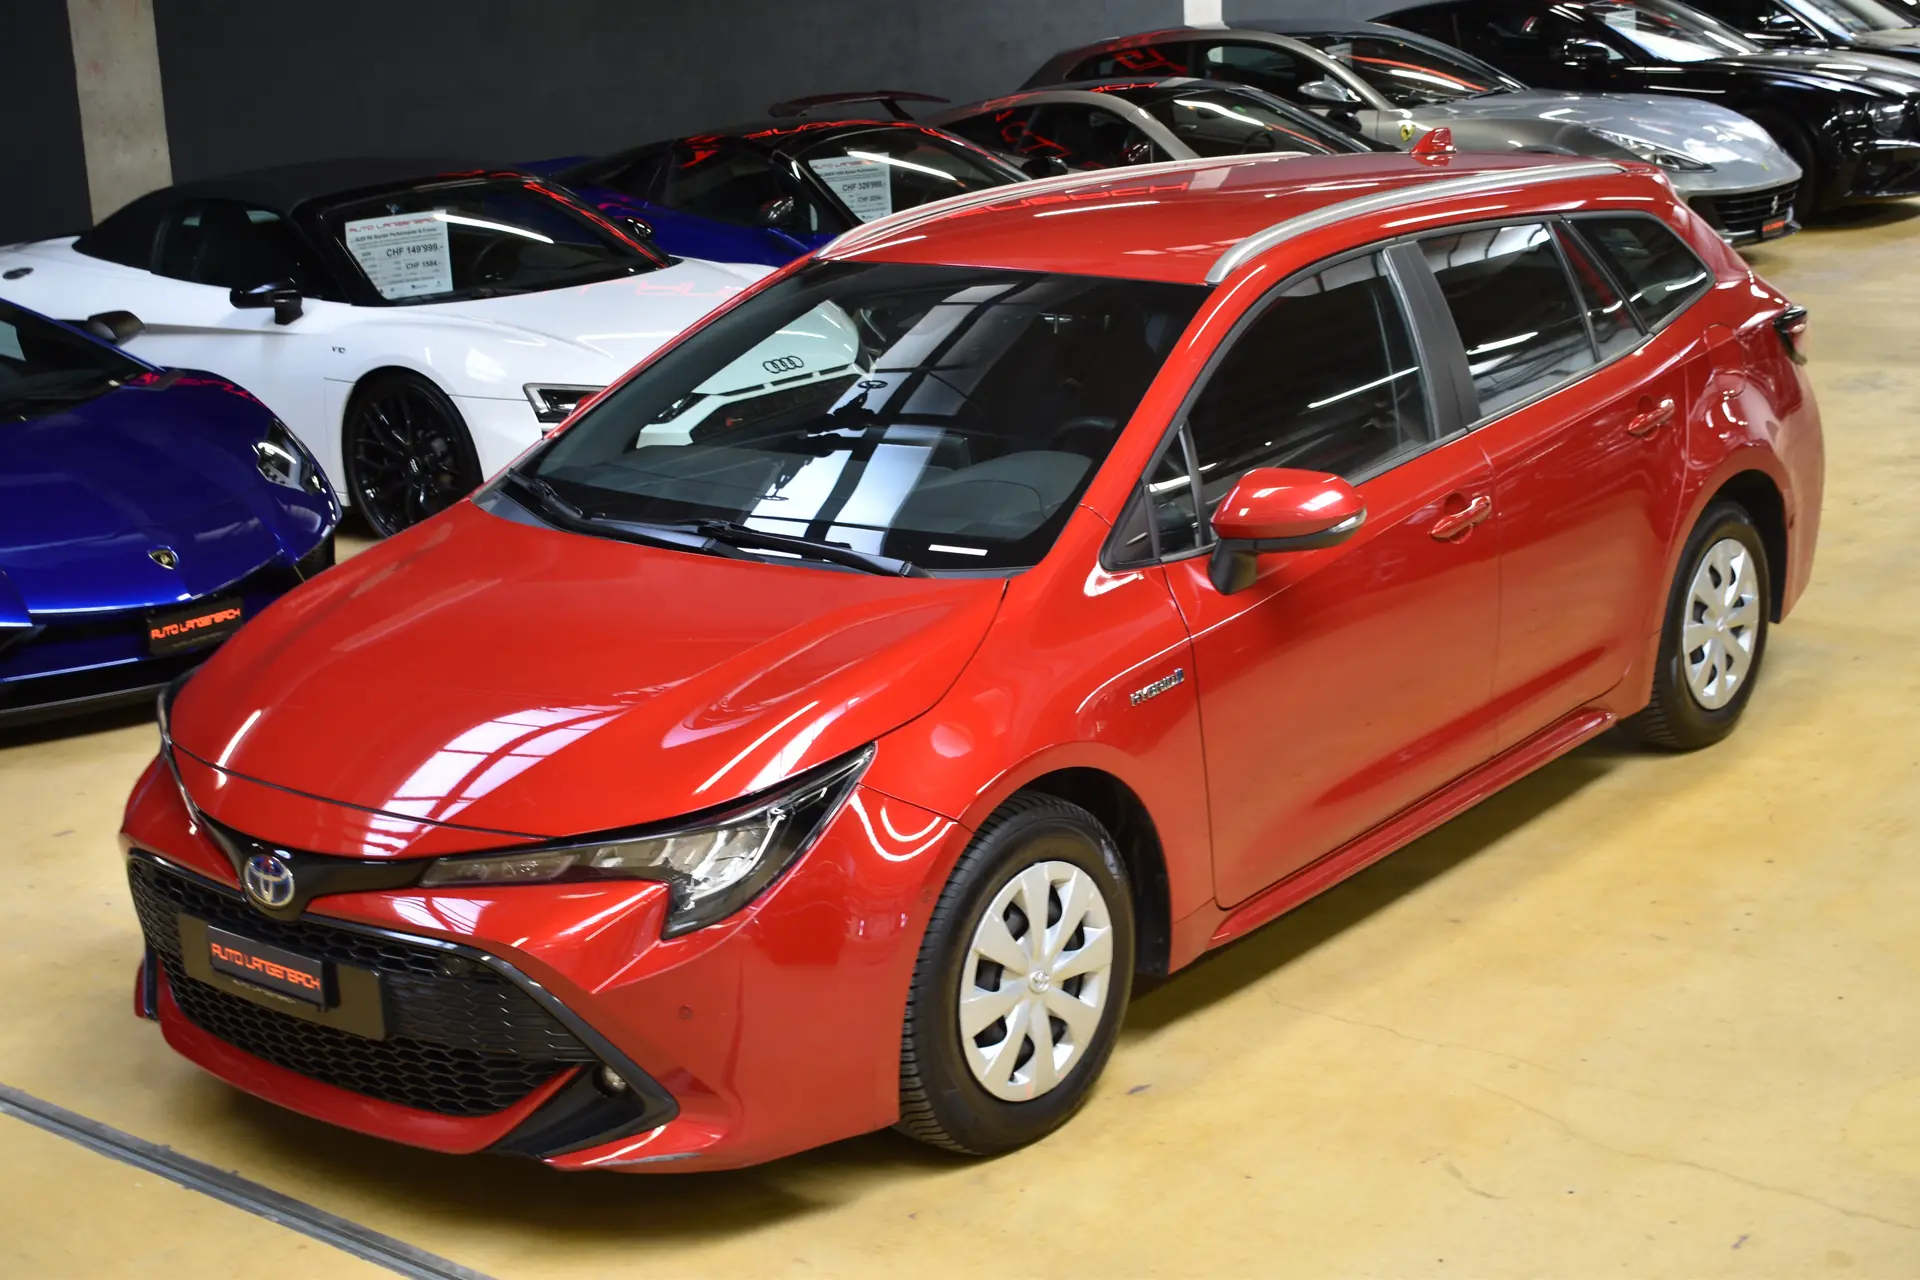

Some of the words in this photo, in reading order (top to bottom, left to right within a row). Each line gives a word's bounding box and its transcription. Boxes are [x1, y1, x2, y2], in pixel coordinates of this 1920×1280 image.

[842, 183, 857, 191] CHF
[386, 247, 404, 257] CHF
[406, 261, 420, 270] CHF
[151, 623, 179, 640] AUTO
[1130, 670, 1181, 707] HYBRID
[211, 942, 244, 966] AUTO
[244, 954, 321, 992] LANGENBACH
